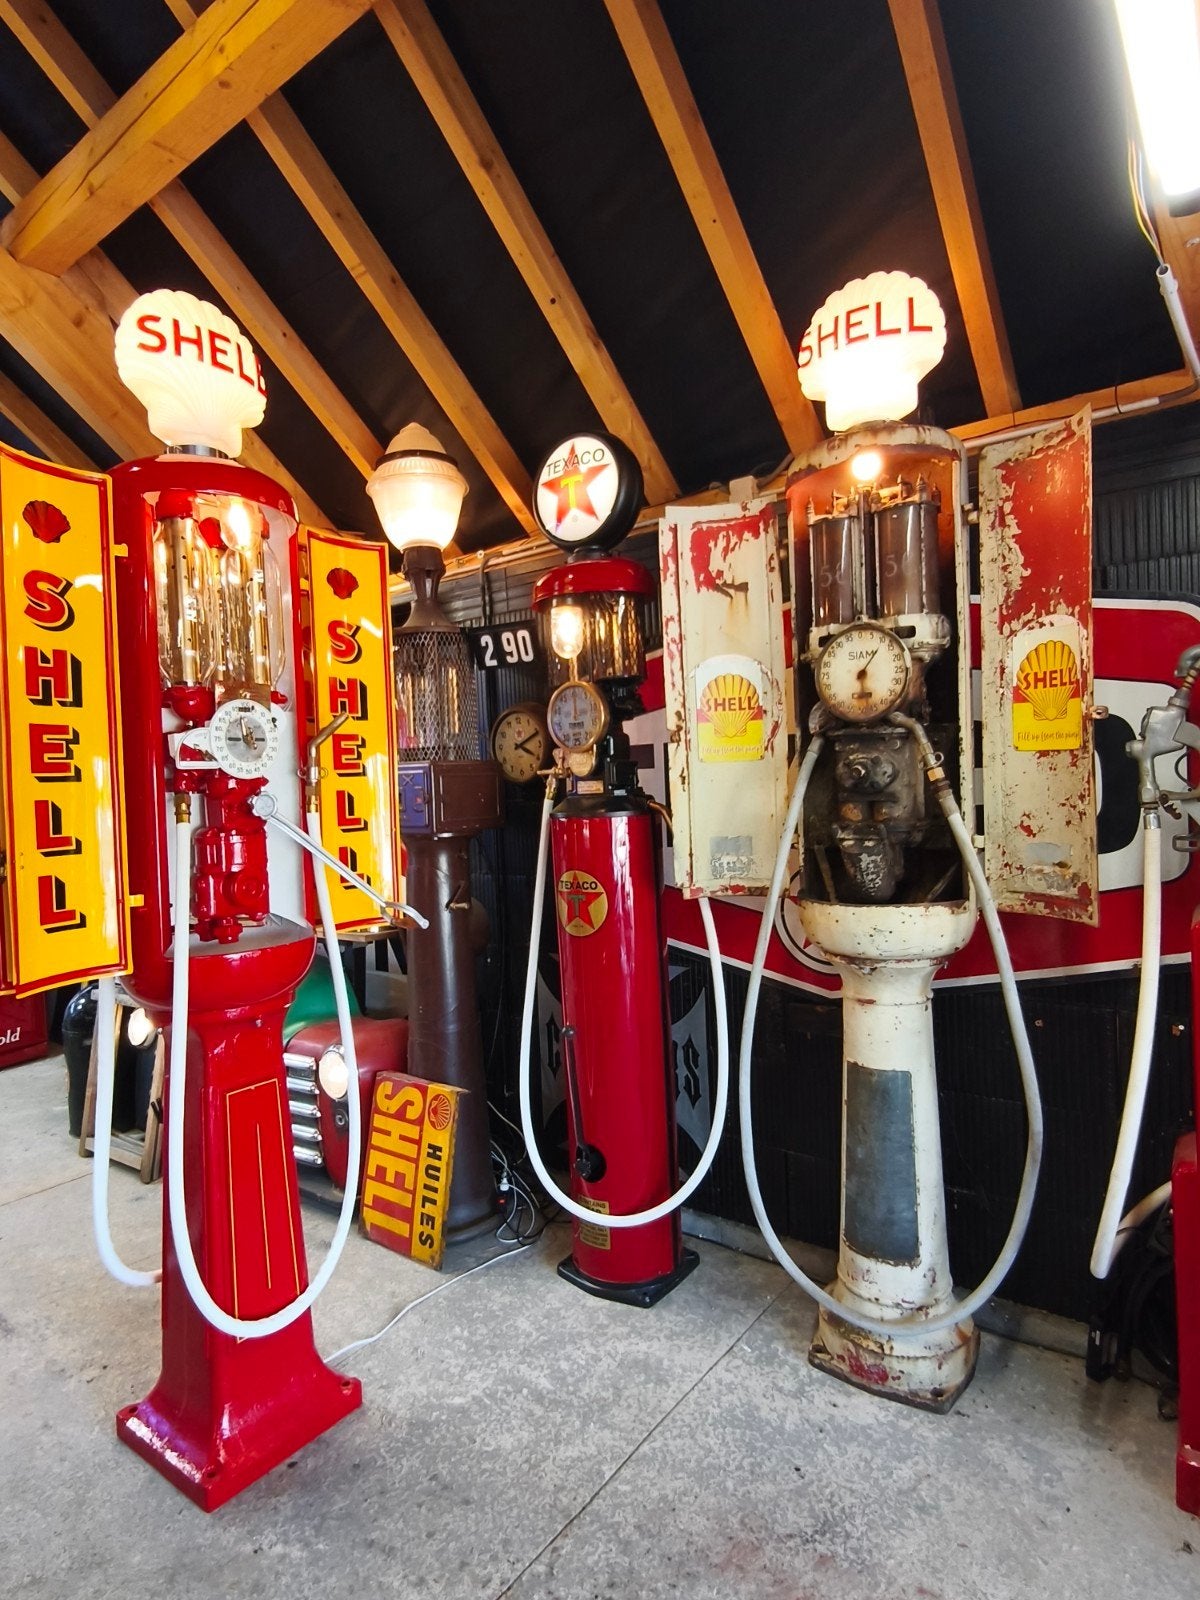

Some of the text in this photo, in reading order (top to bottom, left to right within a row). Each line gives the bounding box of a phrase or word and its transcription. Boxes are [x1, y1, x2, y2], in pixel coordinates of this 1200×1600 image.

[798, 297, 933, 368] SHELL
[136, 315, 267, 398] SHELL
[547, 448, 605, 477] TEXACO
[560, 473, 584, 509] T
[480, 629, 534, 667] 2 90
[848, 649, 875, 661] SIAM
[1022, 667, 1077, 690] SHELL
[706, 696, 756, 712] SHELL
[23, 569, 86, 934] SHELL
[327, 619, 371, 890] SHELL
[560, 880, 598, 890] TEXACO
[363, 1081, 424, 1238] SHELL
[418, 1142, 443, 1250] HUILES
